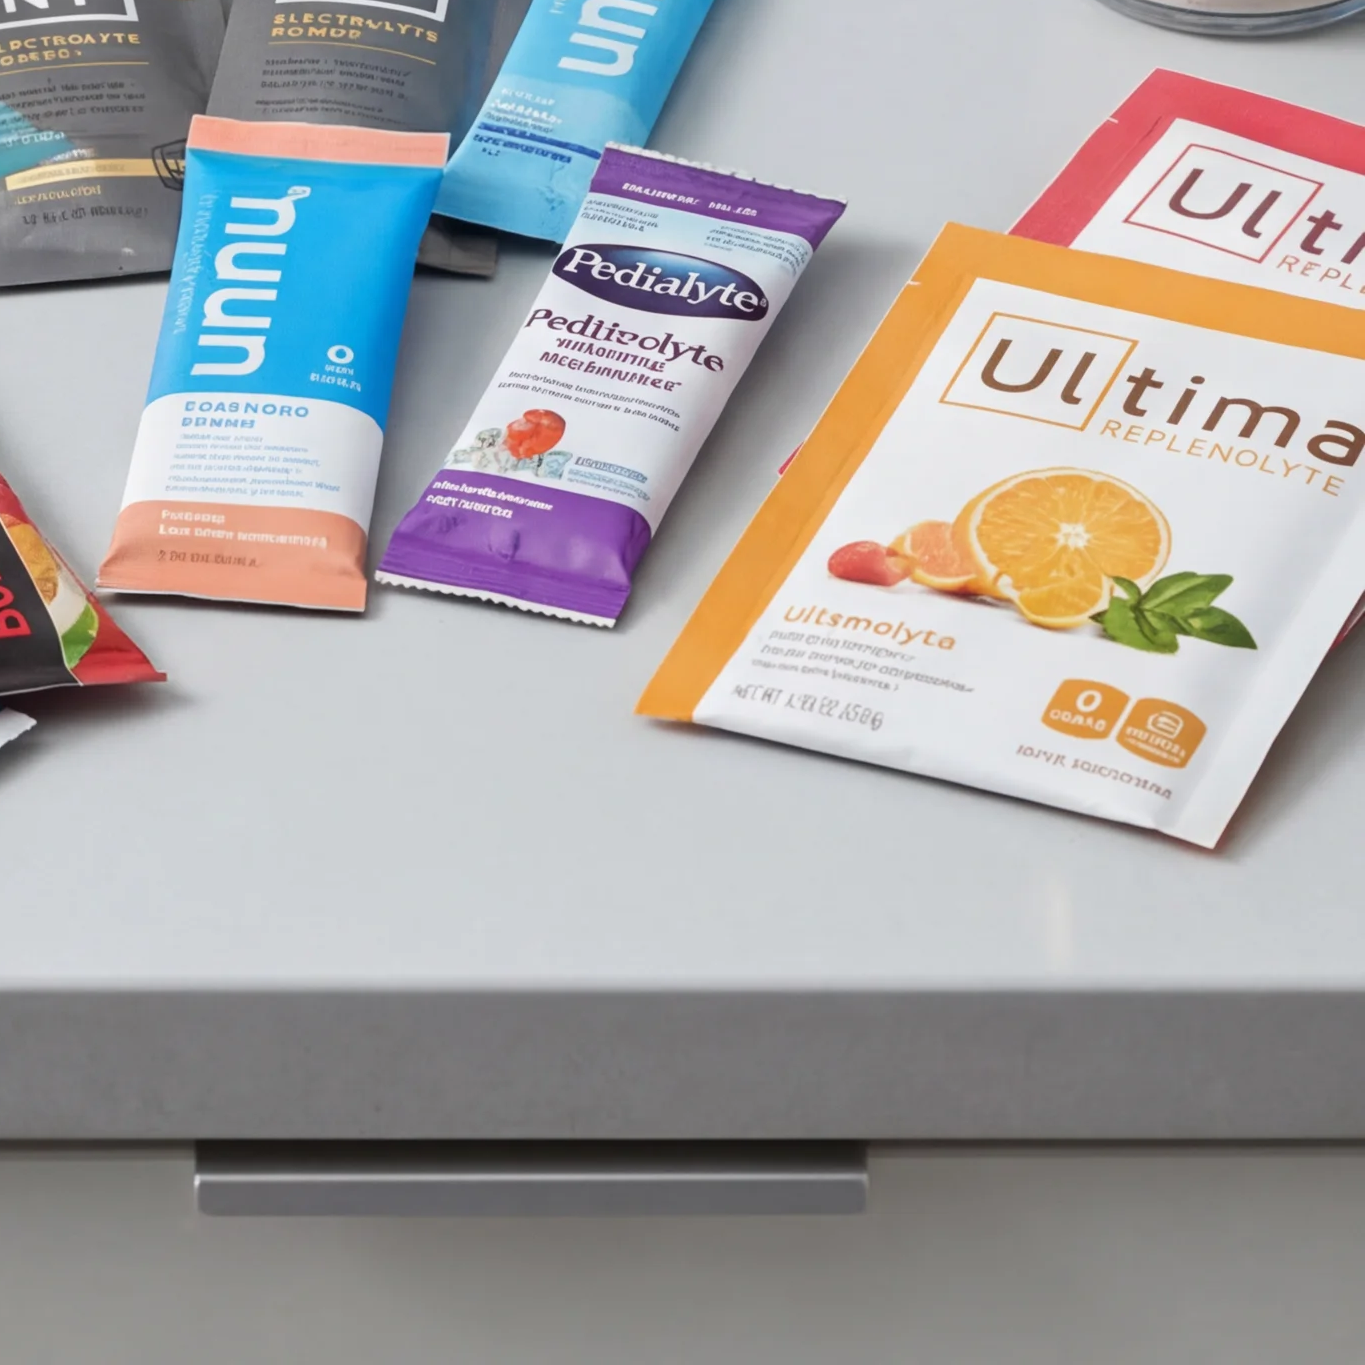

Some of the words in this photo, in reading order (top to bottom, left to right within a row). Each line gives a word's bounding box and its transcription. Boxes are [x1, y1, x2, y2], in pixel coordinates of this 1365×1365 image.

[562, 247, 760, 313] Pedialyte
[978, 336, 1365, 468] Ultima
[1100, 418, 1346, 497] REPLENOLYTE
